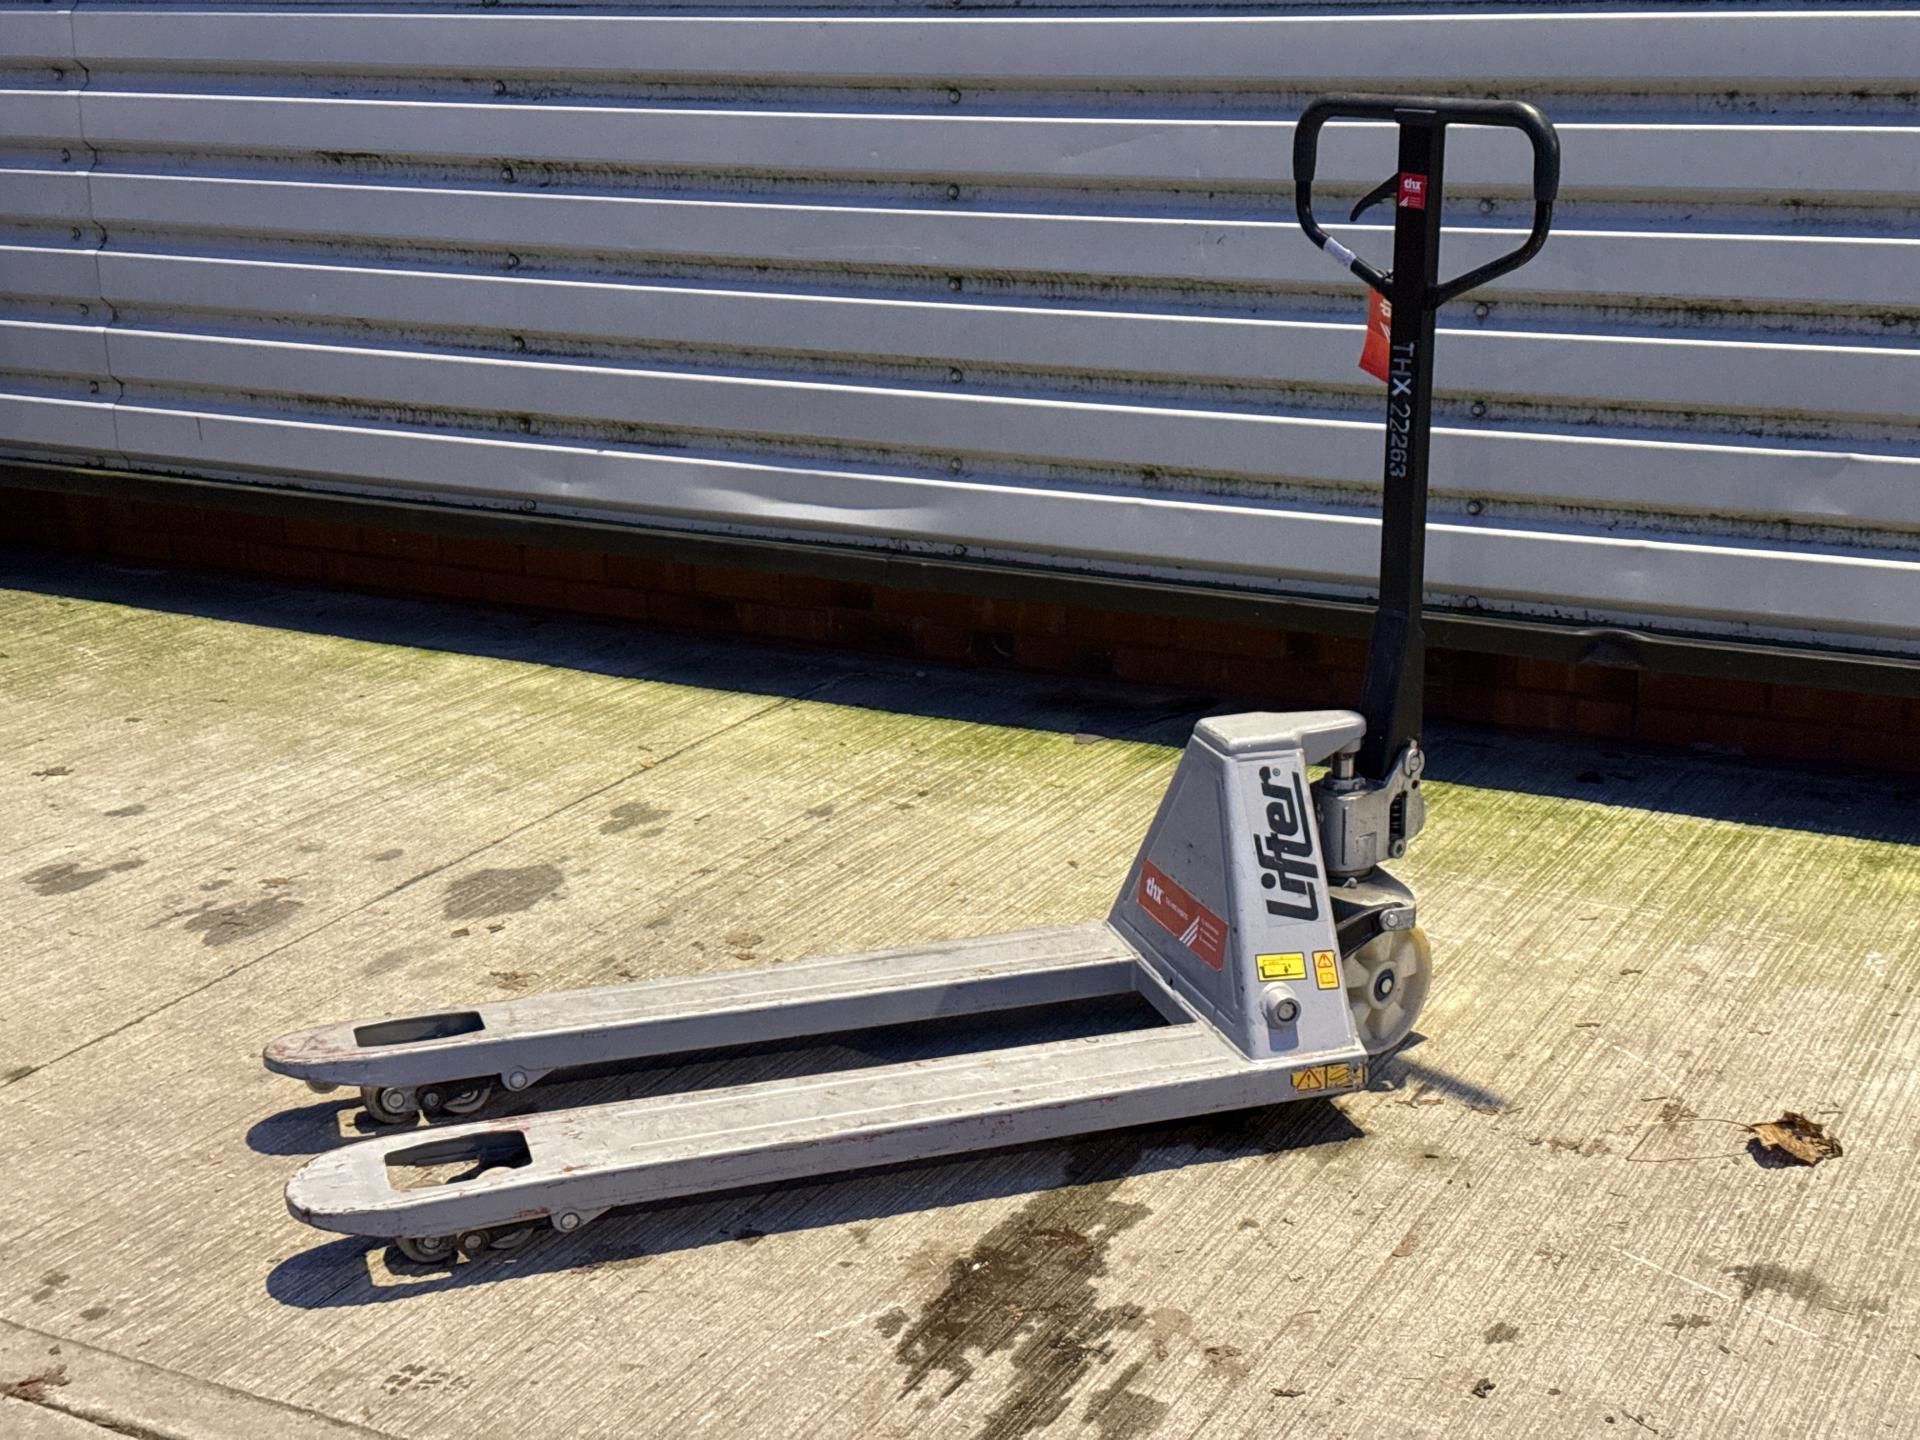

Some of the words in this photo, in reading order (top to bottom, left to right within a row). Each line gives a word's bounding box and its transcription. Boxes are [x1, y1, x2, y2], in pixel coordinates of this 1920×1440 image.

[1391, 341, 1415, 397] THX
[1389, 402, 1411, 477] 22263
[1253, 766, 1319, 921] Lifter
[1146, 877, 1164, 904] thx
